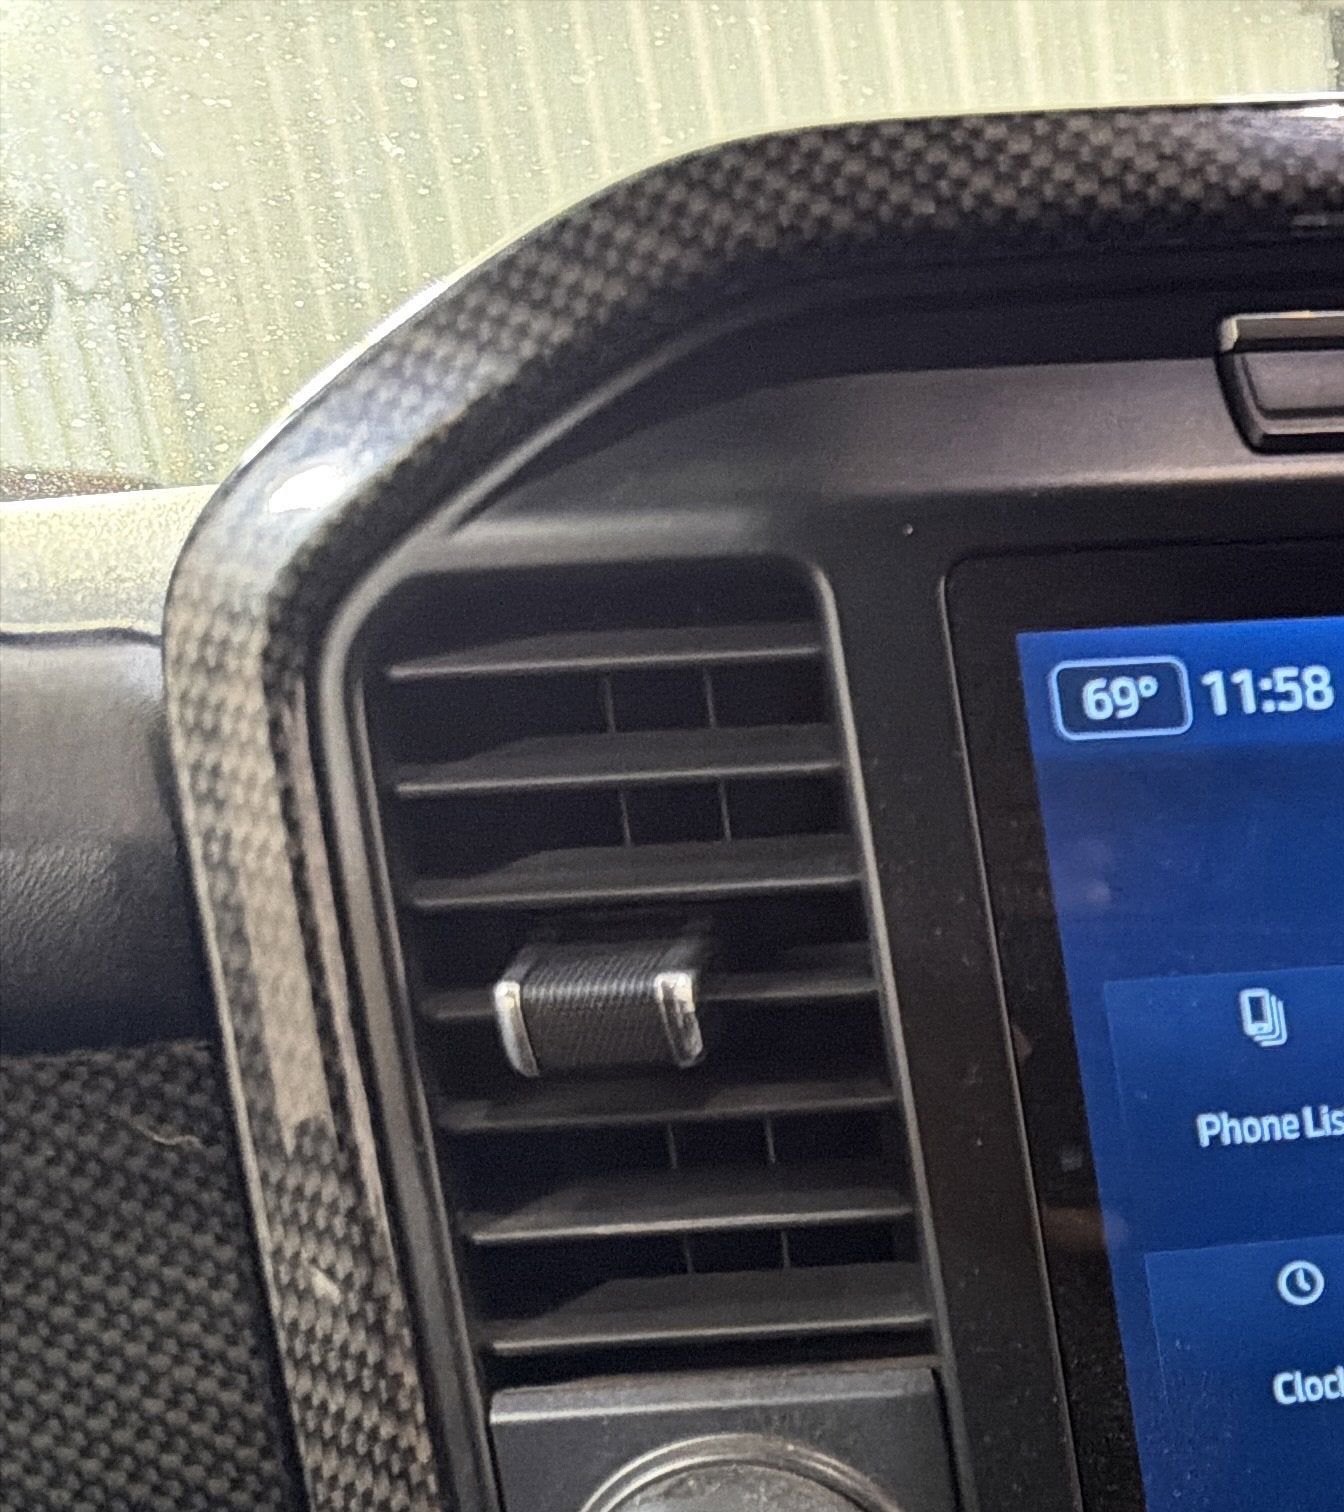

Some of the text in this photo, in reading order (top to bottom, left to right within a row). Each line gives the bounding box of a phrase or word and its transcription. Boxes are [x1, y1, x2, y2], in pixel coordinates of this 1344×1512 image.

[1082, 675, 1159, 721] 69°
[1201, 665, 1335, 716] 11:58
[1196, 1111, 1301, 1148] Phone
